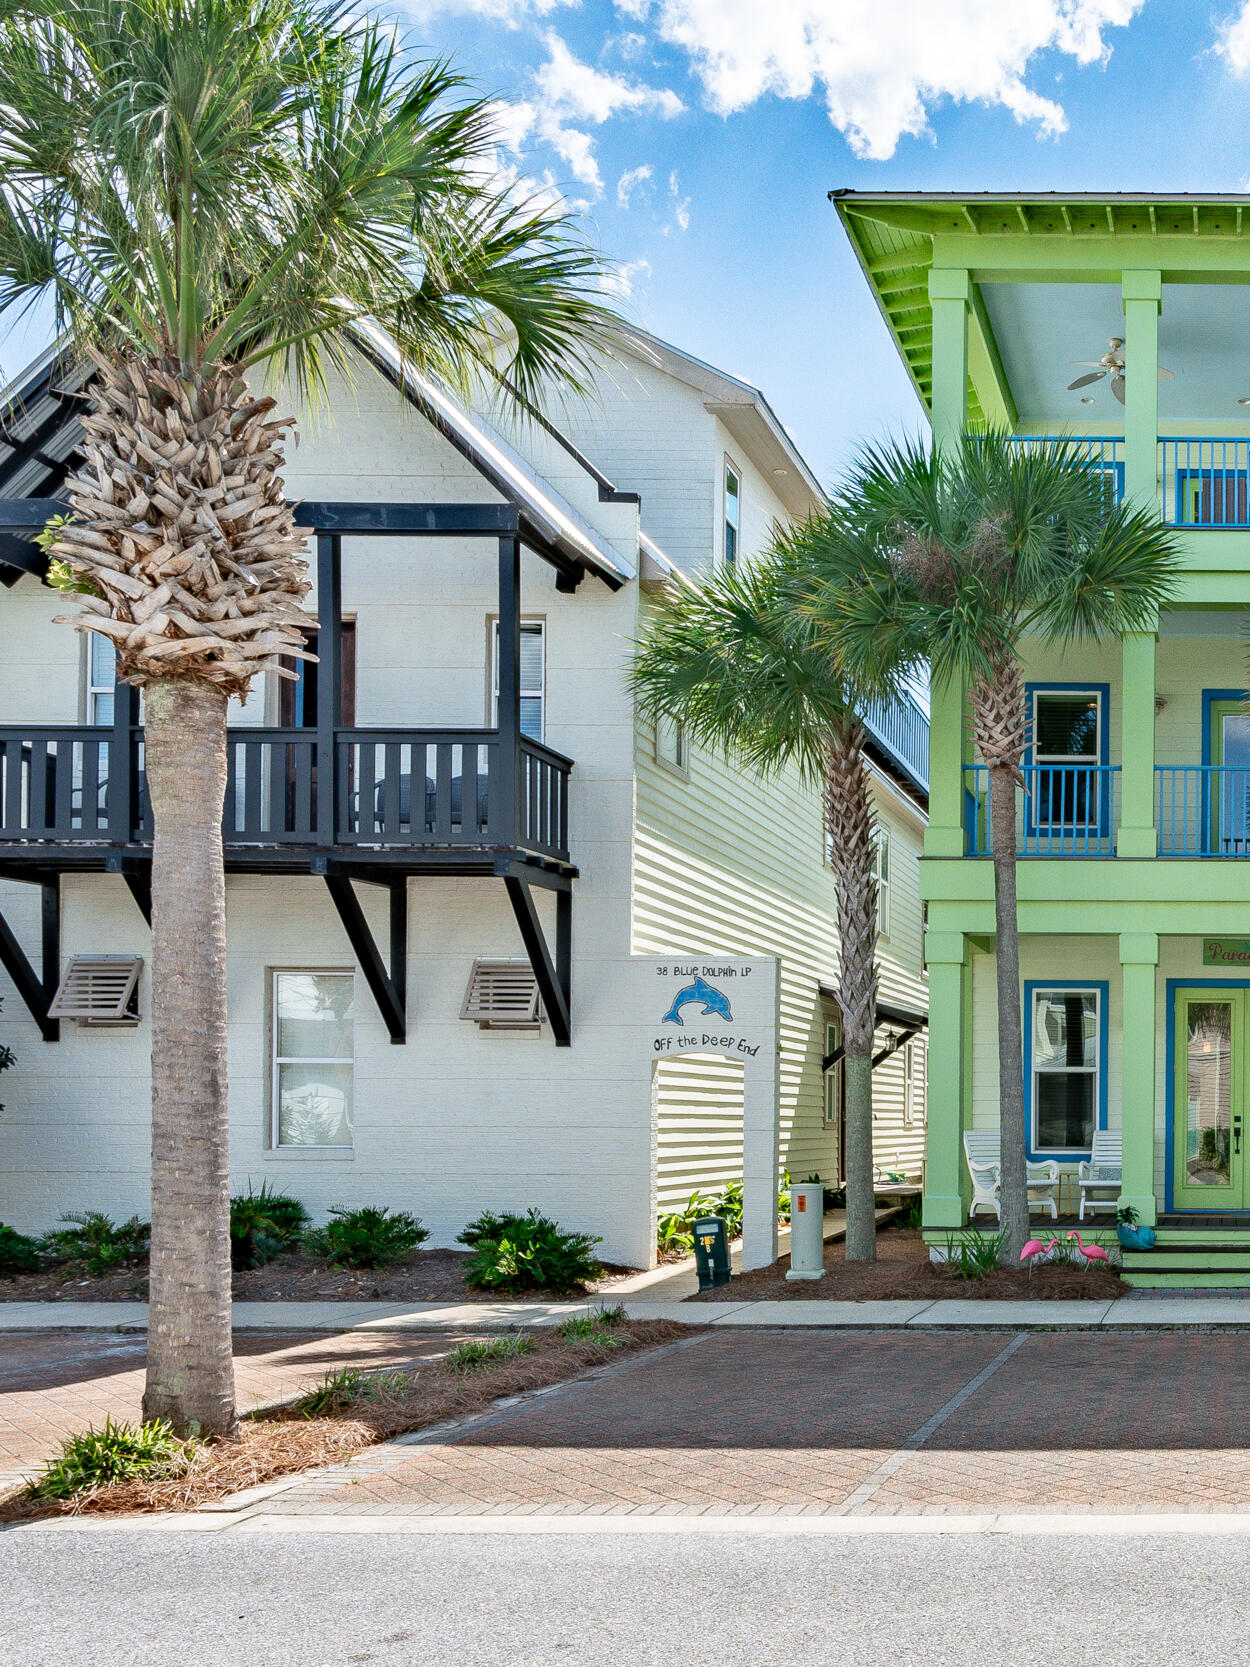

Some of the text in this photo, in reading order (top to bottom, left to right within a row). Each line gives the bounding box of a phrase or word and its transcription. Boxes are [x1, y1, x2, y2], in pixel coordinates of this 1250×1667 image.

[656, 966, 668, 976] 38
[740, 967, 752, 977] LP
[676, 1035, 698, 1048] the
[702, 1033, 736, 1049] Deep
[736, 1038, 761, 1057] End
